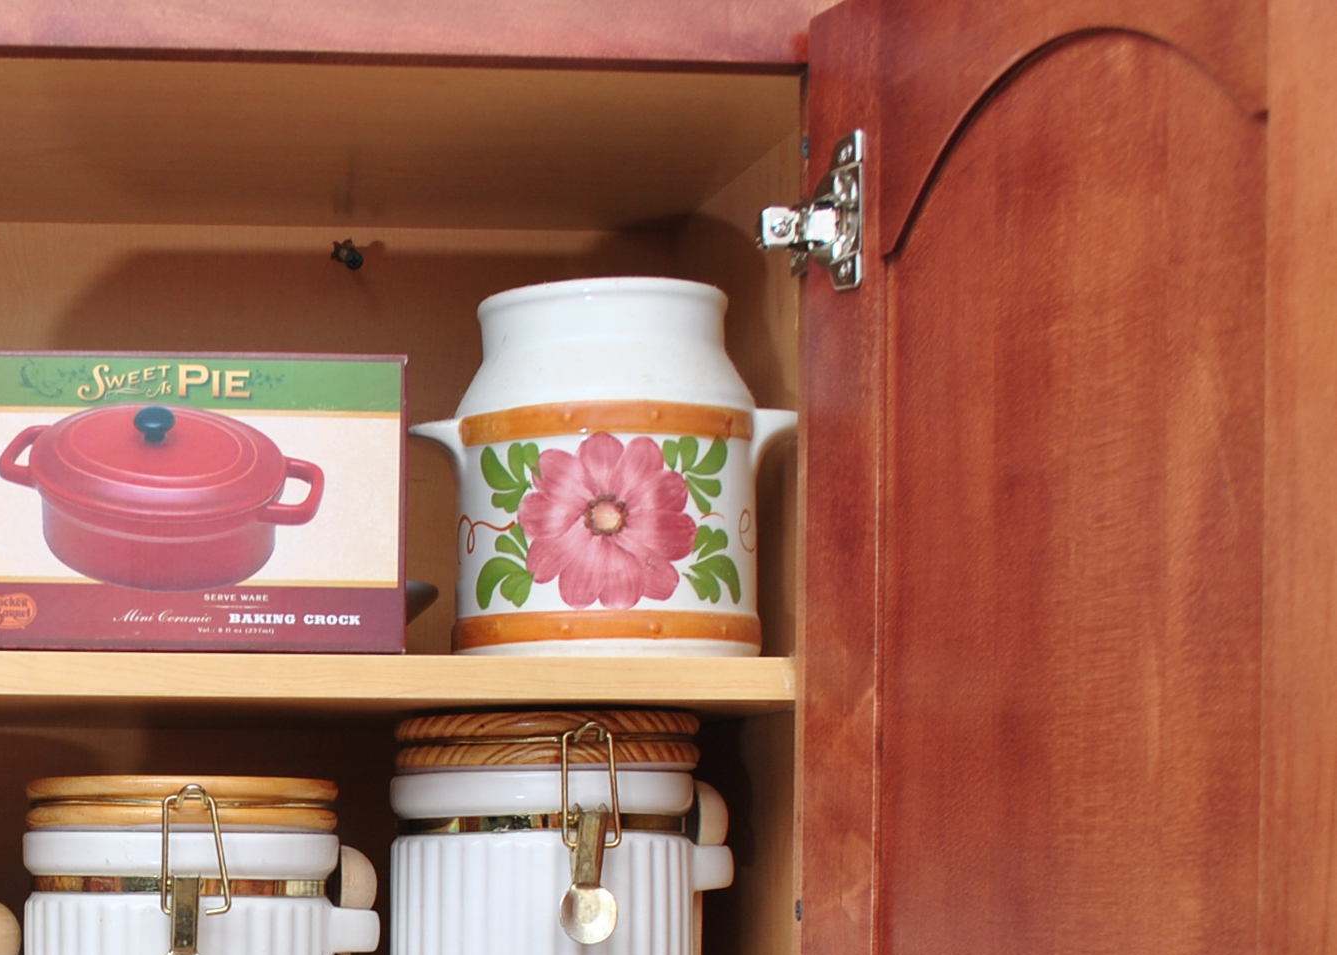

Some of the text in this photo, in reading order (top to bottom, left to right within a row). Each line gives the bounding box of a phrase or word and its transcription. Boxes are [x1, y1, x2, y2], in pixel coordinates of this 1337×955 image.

[178, 364, 251, 399] PIE
[203, 593, 270, 602] SERVE WARE
[112, 608, 361, 626] Mini Ceramic BAKING CROCK
